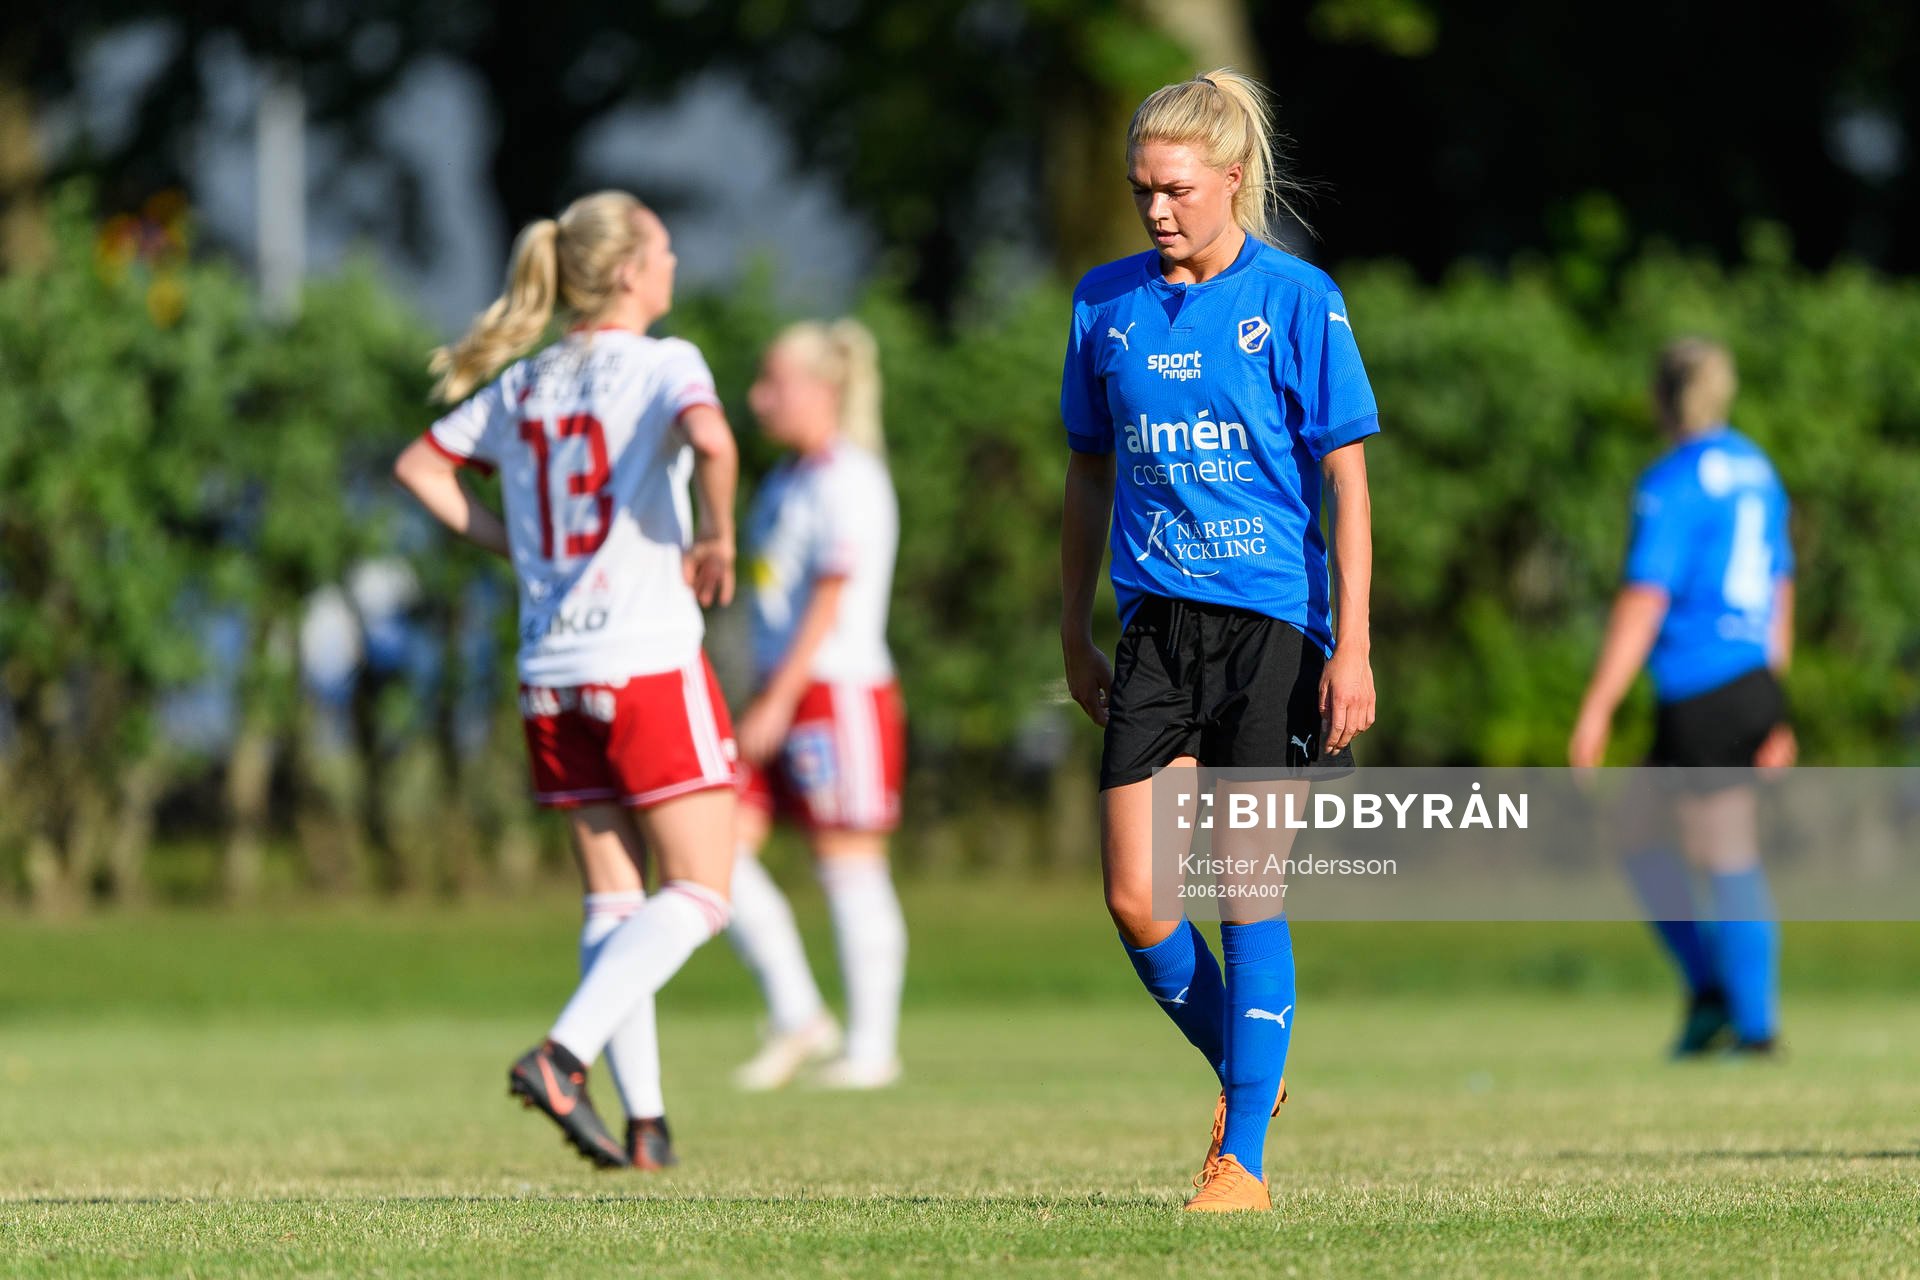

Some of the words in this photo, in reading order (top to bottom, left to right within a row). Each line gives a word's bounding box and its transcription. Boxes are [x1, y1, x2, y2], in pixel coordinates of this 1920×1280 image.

[1147, 350, 1202, 373] sport
[1163, 368, 1201, 382] ringen
[1124, 409, 1249, 454] almén
[1133, 454, 1254, 486] cosmetic
[518, 413, 613, 560] 13
[1176, 516, 1264, 540] NÄREDS
